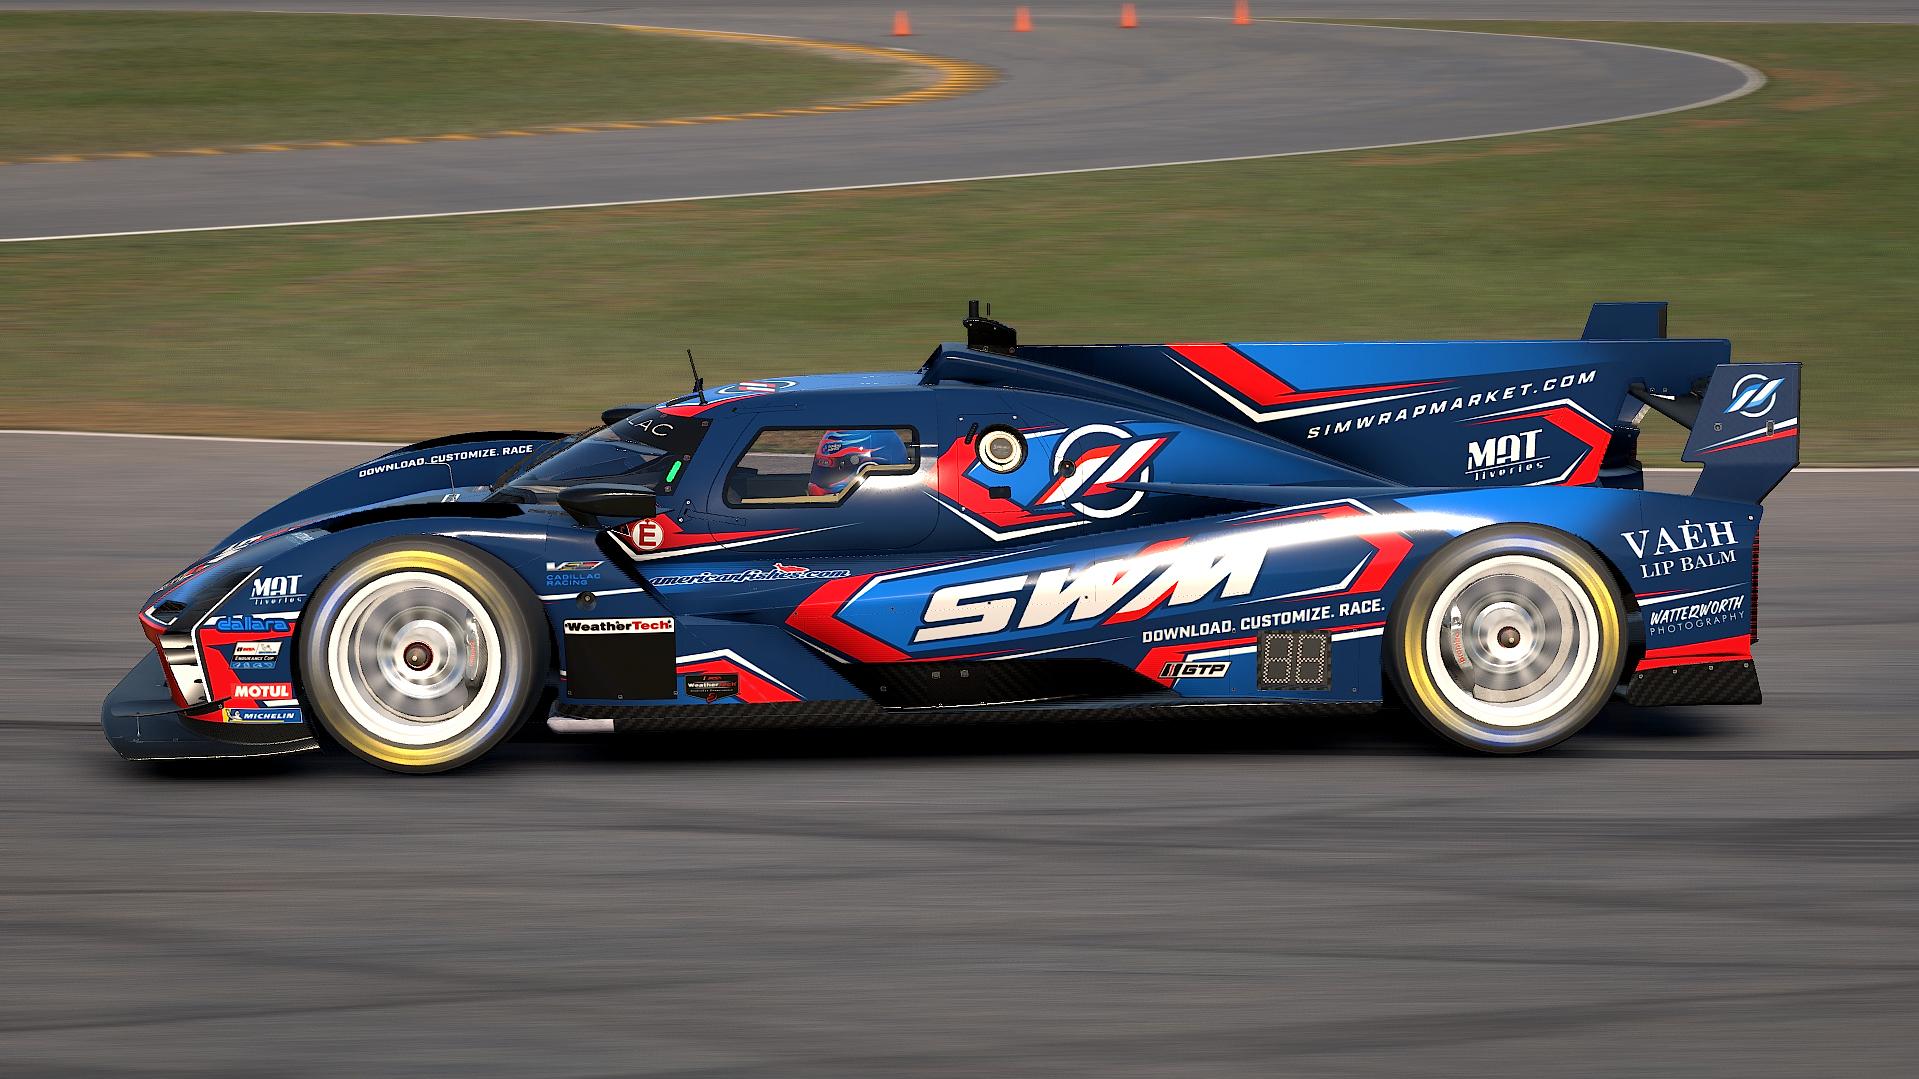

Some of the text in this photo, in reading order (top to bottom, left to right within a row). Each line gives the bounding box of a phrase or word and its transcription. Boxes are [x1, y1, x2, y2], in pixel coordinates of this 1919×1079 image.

[1307, 370, 1597, 439] SIMWRAPMARKET.COM
[1467, 428, 1543, 471] MAT
[359, 458, 428, 478] DOWNLOAD.
[430, 448, 500, 464] CUSTOMIZE.
[1475, 461, 1544, 481] liveries
[1640, 550, 1737, 579] LIP BALM
[251, 575, 303, 597] MAT
[546, 573, 601, 581] CADILLAC
[650, 569, 851, 587] americanfishes.com
[913, 540, 1270, 644] SWM
[1142, 598, 1385, 643] DOWNLOAD. CUSTOMIZE. RACE.
[1650, 595, 1745, 626] WATTERWORTH
[218, 616, 289, 631] dallara
[567, 620, 669, 632] WeatherTech
[1650, 610, 1745, 636] PHOTOGRAPHY
[1182, 664, 1226, 675] GTP
[234, 685, 289, 698] MOTUL
